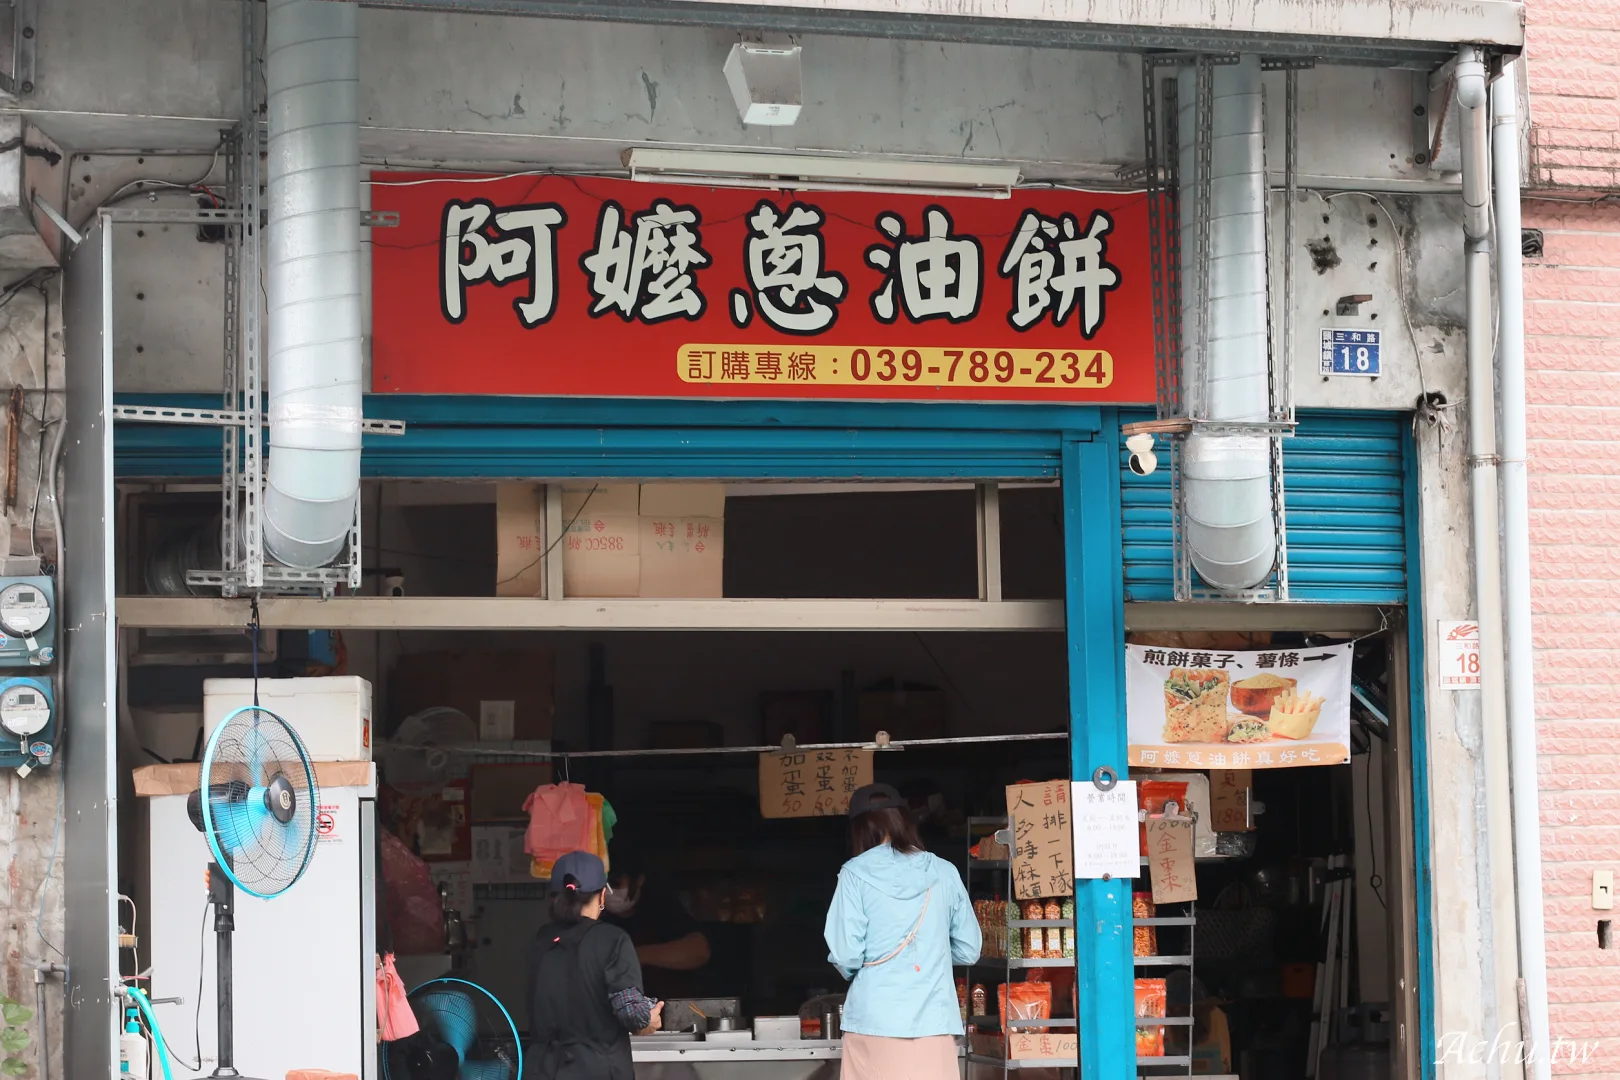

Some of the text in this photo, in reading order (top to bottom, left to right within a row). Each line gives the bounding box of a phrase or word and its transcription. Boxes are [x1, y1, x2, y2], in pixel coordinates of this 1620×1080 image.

[442, 200, 1119, 337] 阿嬤蔥油餅
[1335, 332, 1376, 343] 三和路
[1341, 346, 1370, 371] 18
[1143, 649, 1300, 669] 煎餅菓子、薯條
[1456, 653, 1480, 673] 18
[1087, 792, 1126, 804] 營業時間
